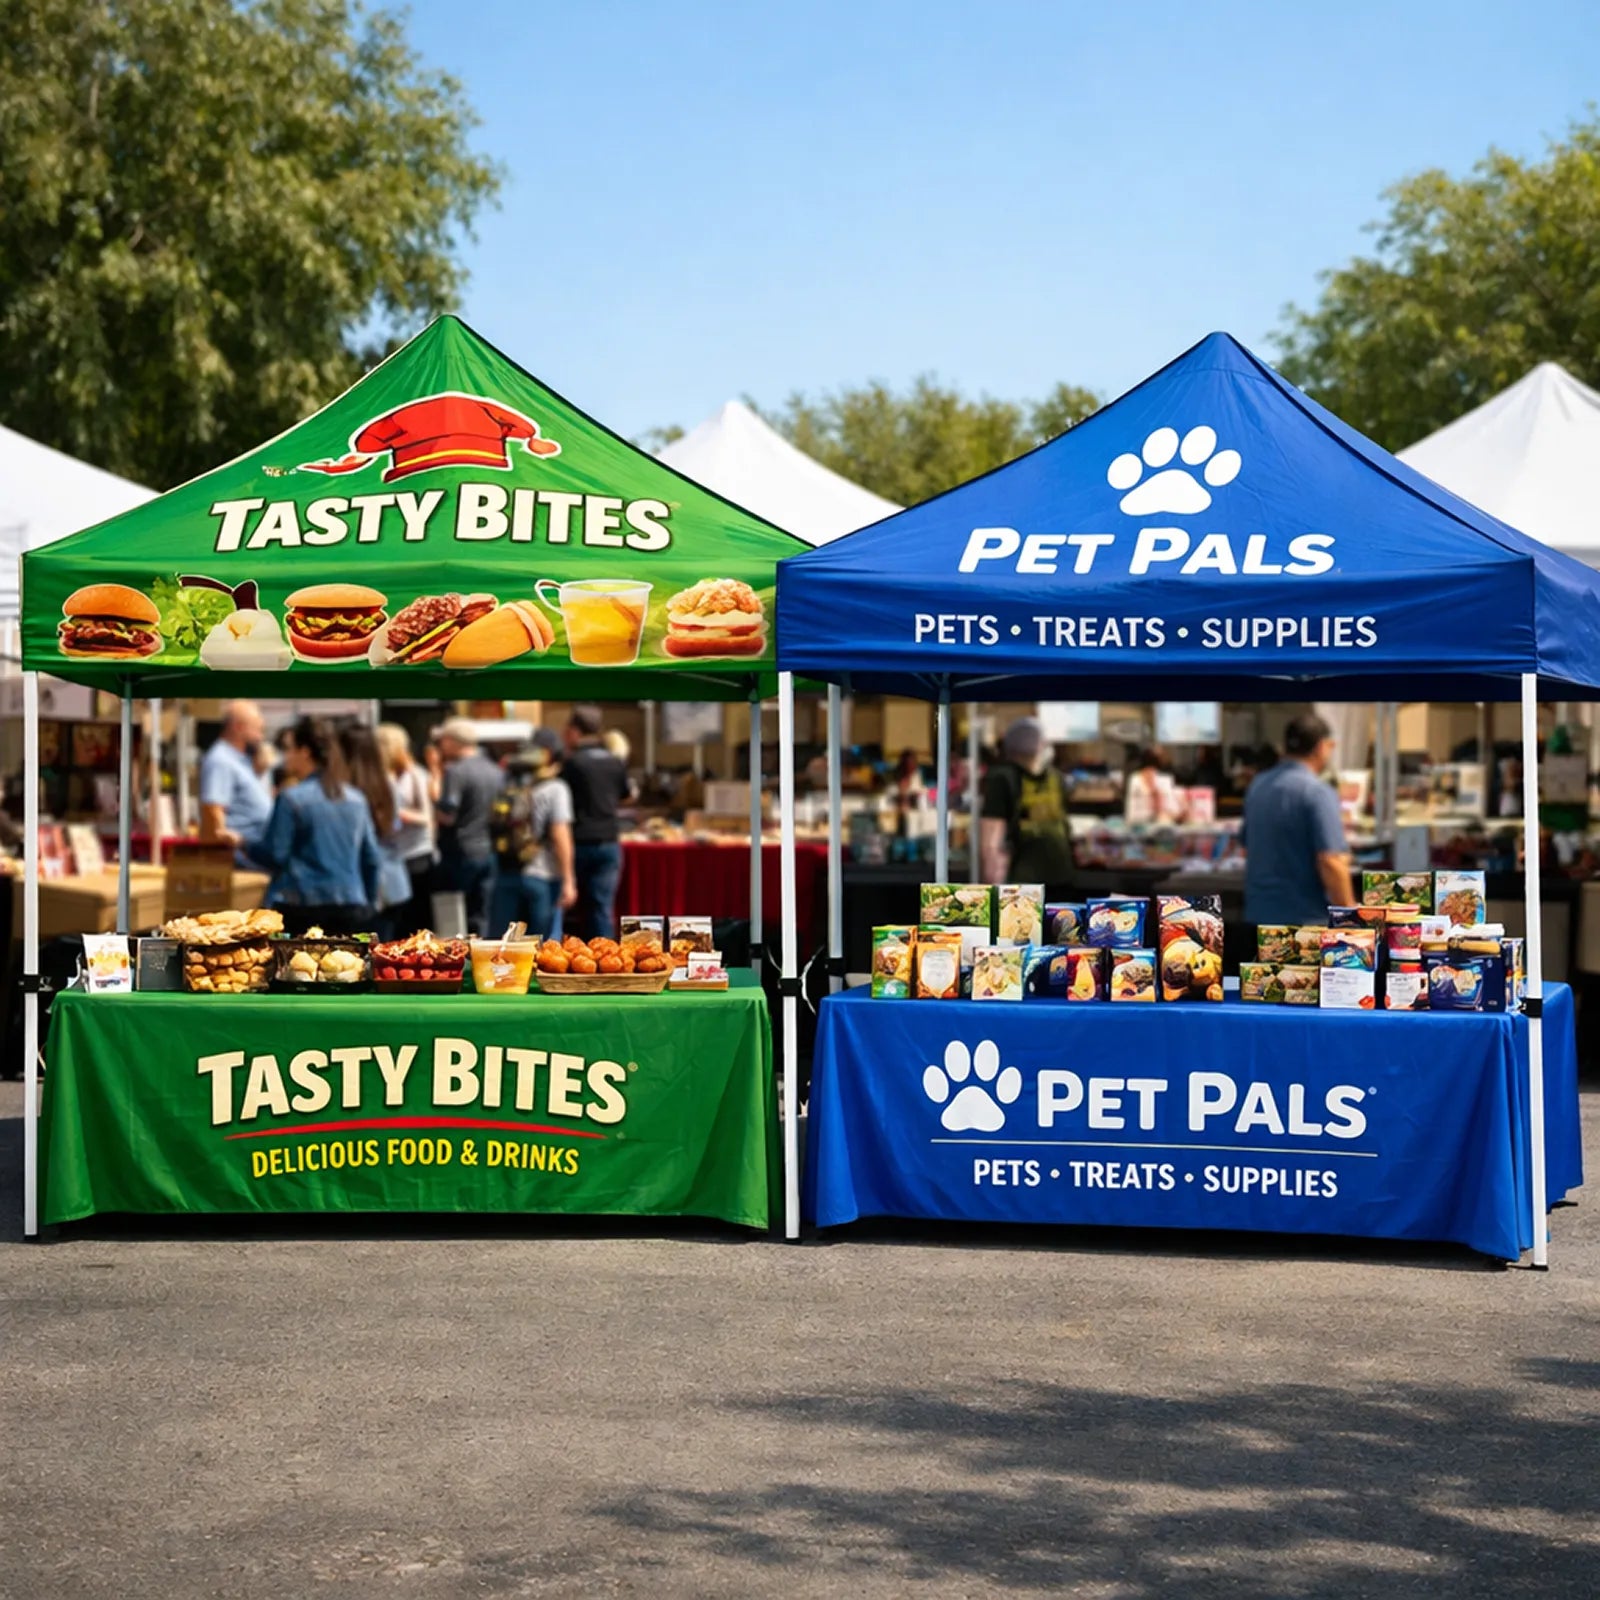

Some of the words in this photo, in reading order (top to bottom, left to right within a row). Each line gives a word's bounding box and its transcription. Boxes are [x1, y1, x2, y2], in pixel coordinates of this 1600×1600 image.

[211, 490, 444, 552] TASTY
[456, 483, 672, 551] BITES
[959, 527, 1114, 575] PET
[1128, 527, 1335, 576] PALS
[915, 614, 999, 645] PETS
[1032, 616, 1165, 648] TREATS
[1202, 616, 1377, 648] SUPPLIES
[197, 1045, 419, 1126] TASTY
[433, 1038, 627, 1124] BITES
[1037, 1069, 1168, 1130] PET
[1188, 1071, 1367, 1139] PALS
[252, 1140, 380, 1178] DELICIOUS
[387, 1138, 453, 1166] FOOD
[460, 1139, 478, 1166] &
[487, 1140, 579, 1175] DRINKS
[974, 1159, 1041, 1187] PETS
[1069, 1161, 1175, 1191] TREATS
[1203, 1165, 1338, 1198] SUPPLIES
